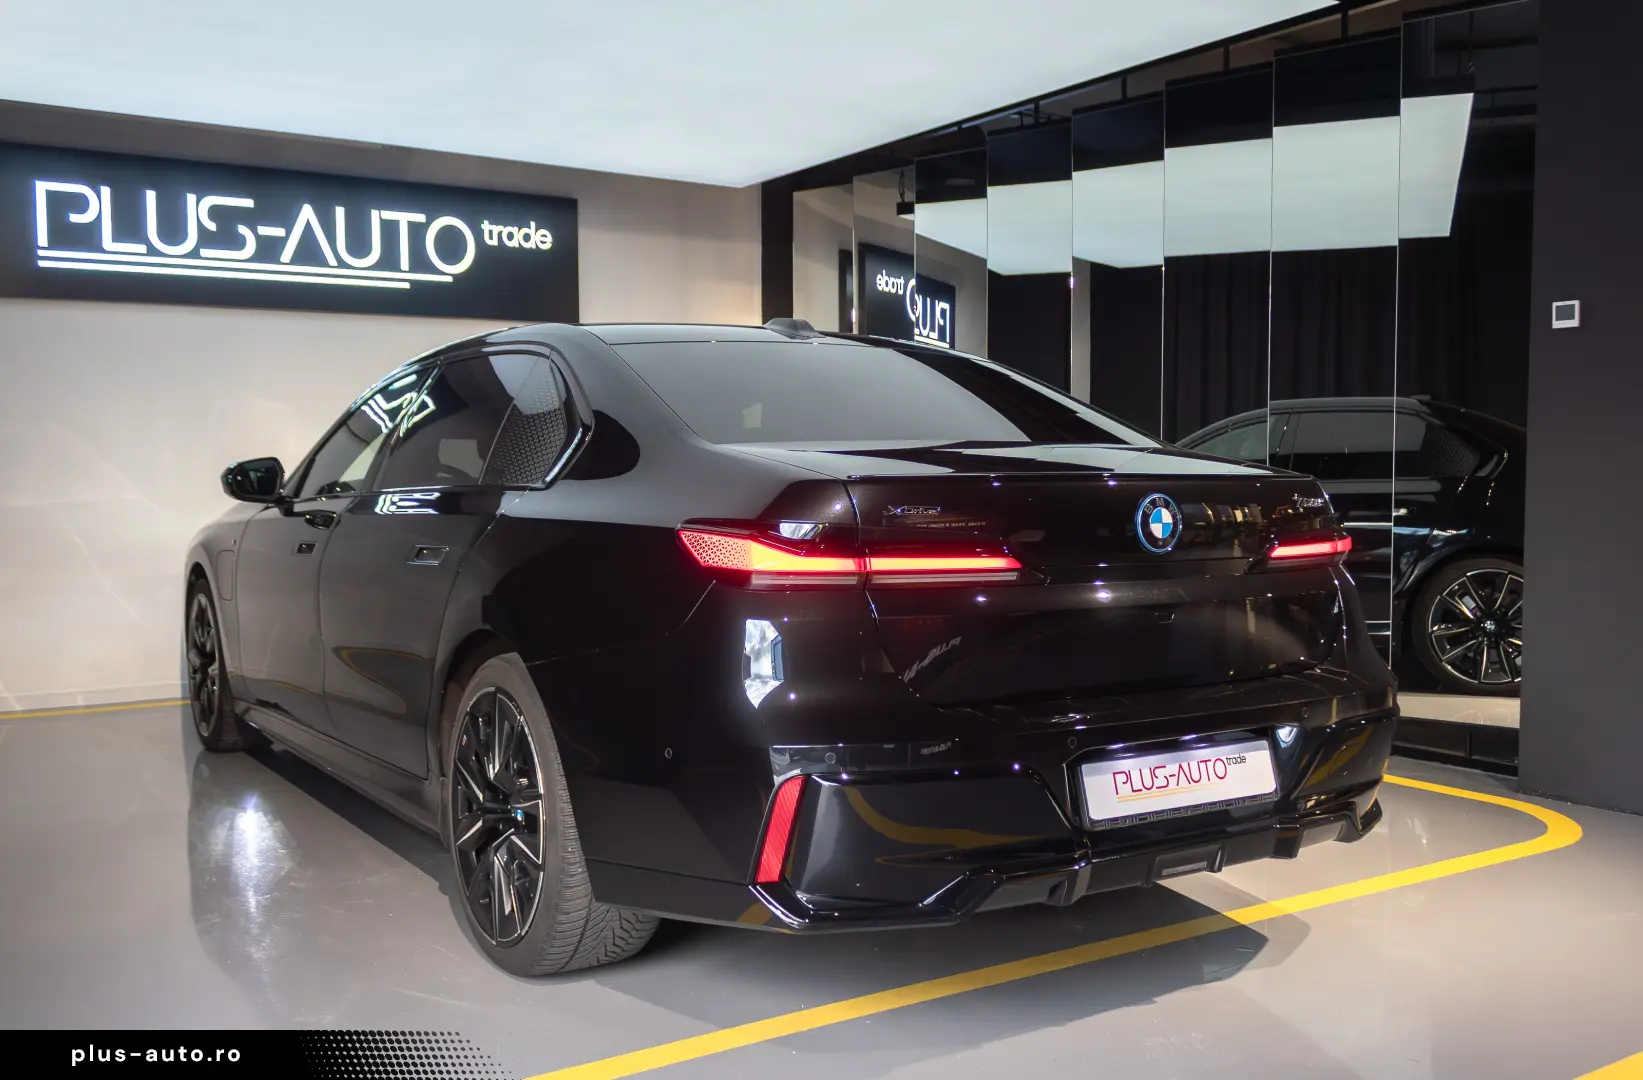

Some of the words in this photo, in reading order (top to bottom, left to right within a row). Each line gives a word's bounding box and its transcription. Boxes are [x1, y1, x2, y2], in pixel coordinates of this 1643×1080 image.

[34, 179, 476, 275] PLUS-AUTO
[481, 220, 553, 251] trade
[1112, 757, 1228, 795] PLUS-AUTO
[1226, 754, 1247, 766] trade
